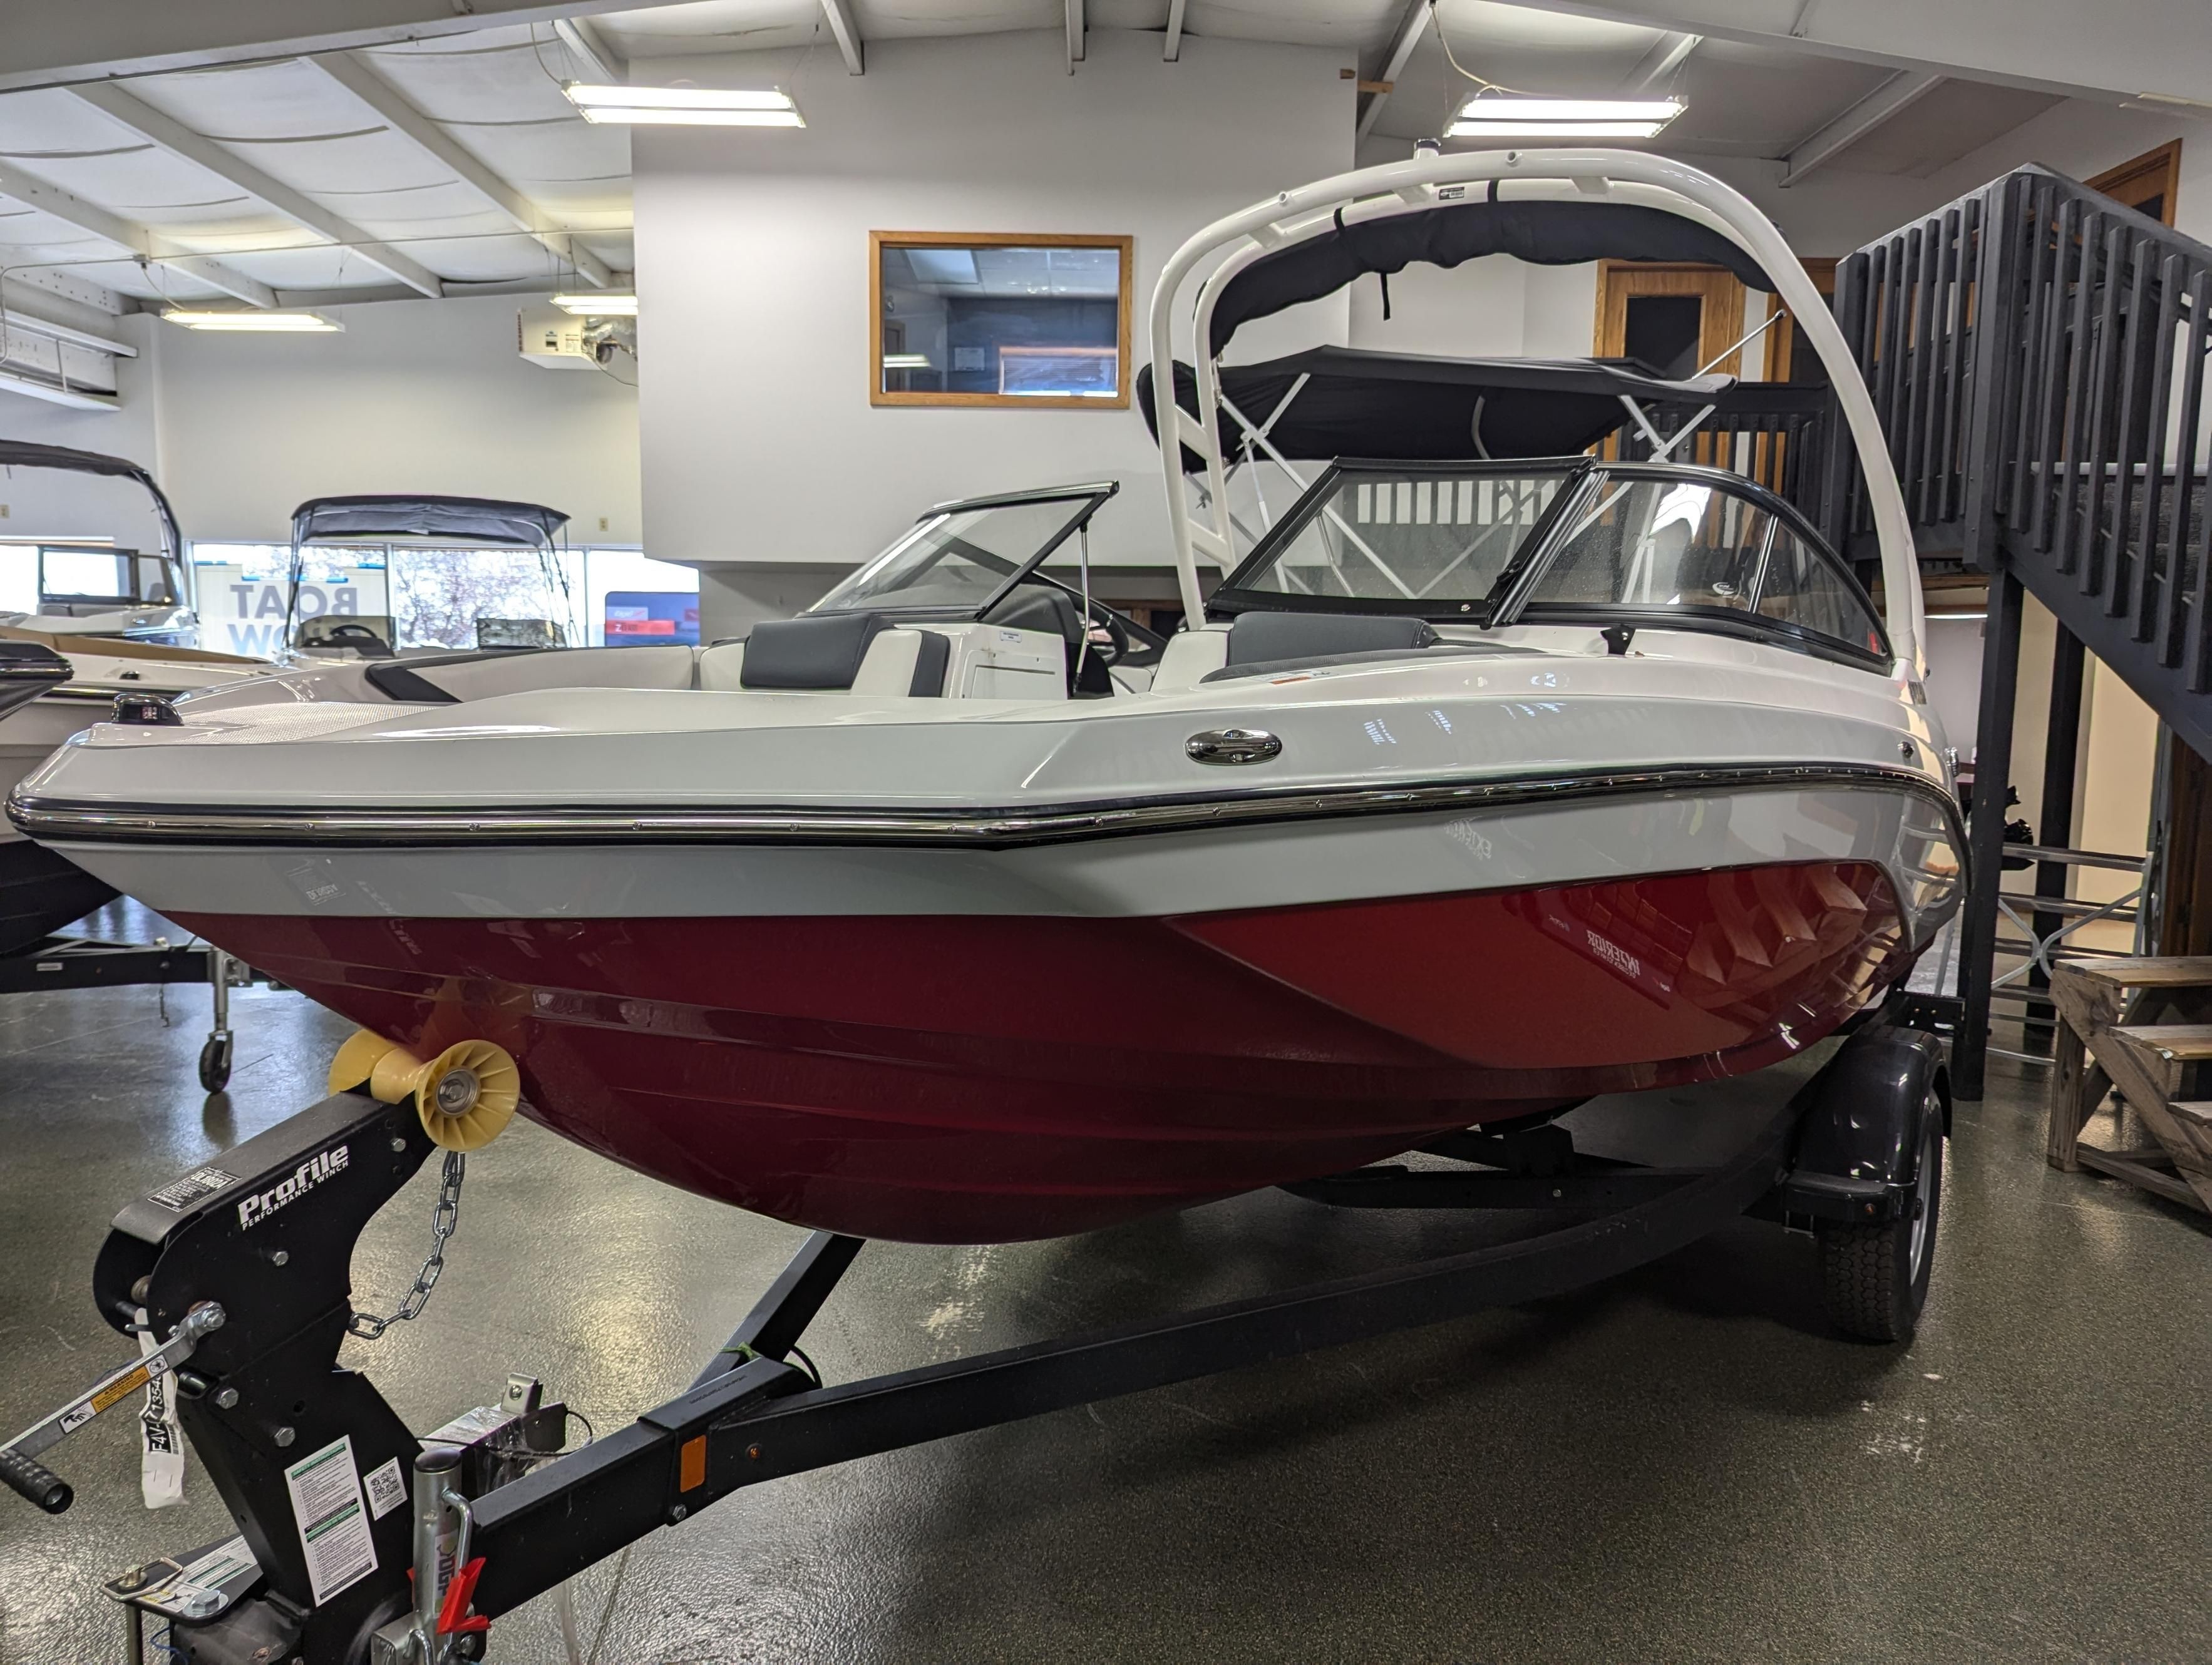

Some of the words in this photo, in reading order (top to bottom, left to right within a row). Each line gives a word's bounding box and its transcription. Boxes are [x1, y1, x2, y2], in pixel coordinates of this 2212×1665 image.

[237, 1145, 349, 1225] Profile
[242, 1181, 314, 1232] PERFORMANCE
[316, 1160, 349, 1184] WINCH
